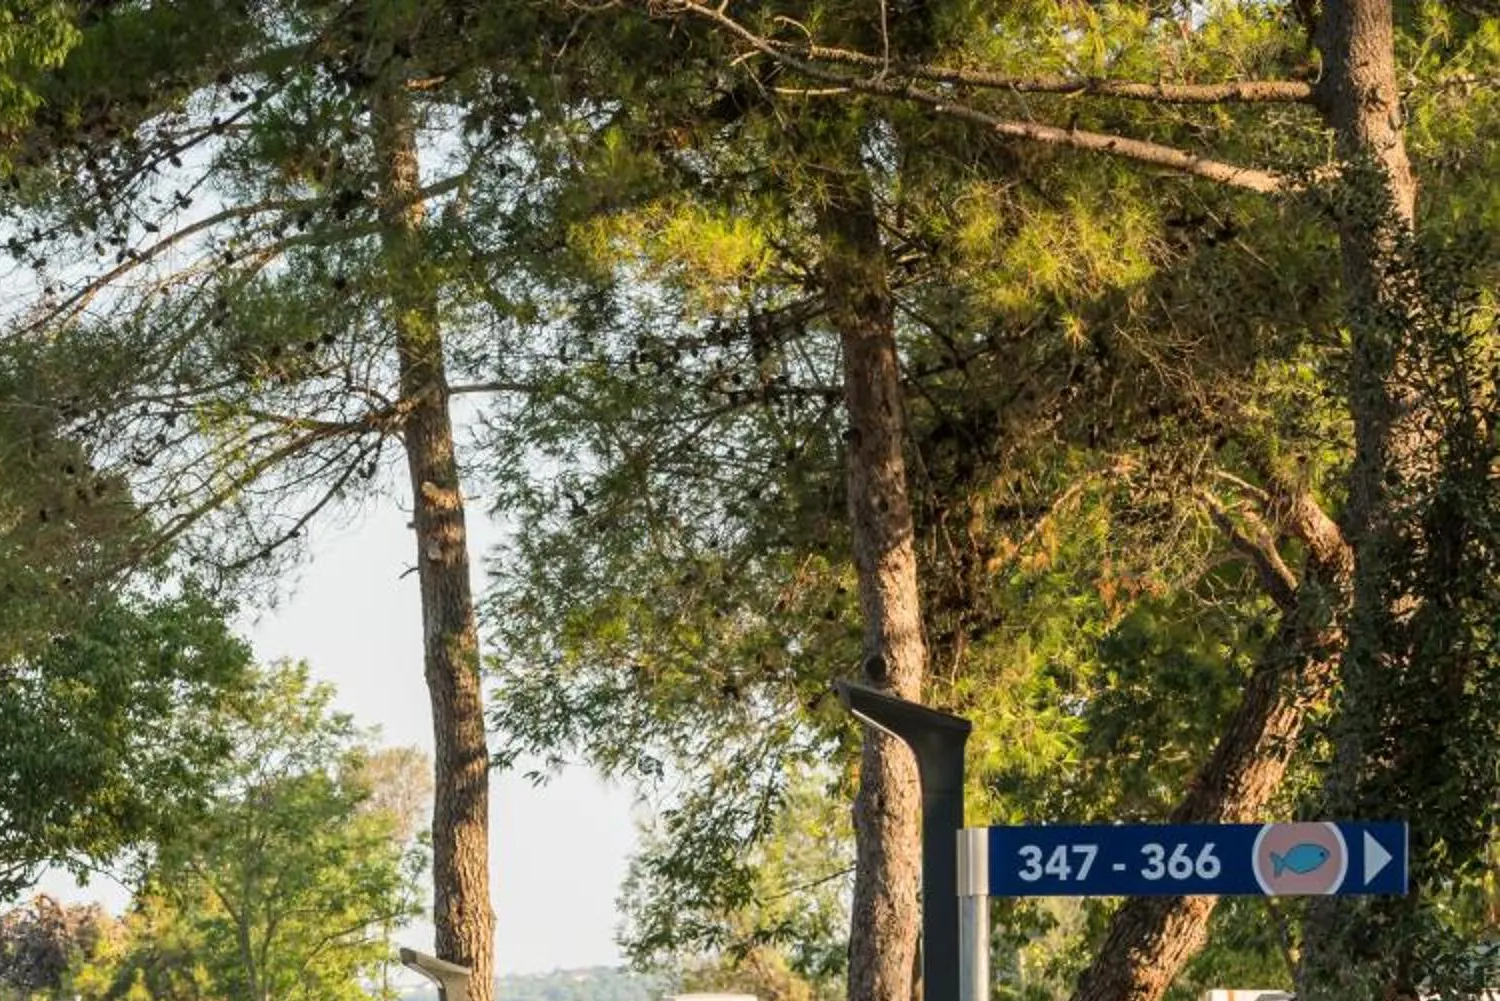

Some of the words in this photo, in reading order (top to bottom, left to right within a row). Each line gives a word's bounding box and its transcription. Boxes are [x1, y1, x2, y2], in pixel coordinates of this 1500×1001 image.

[1018, 844, 1099, 881] 347
[1112, 863, 1126, 871] -
[1140, 843, 1221, 880] 366
